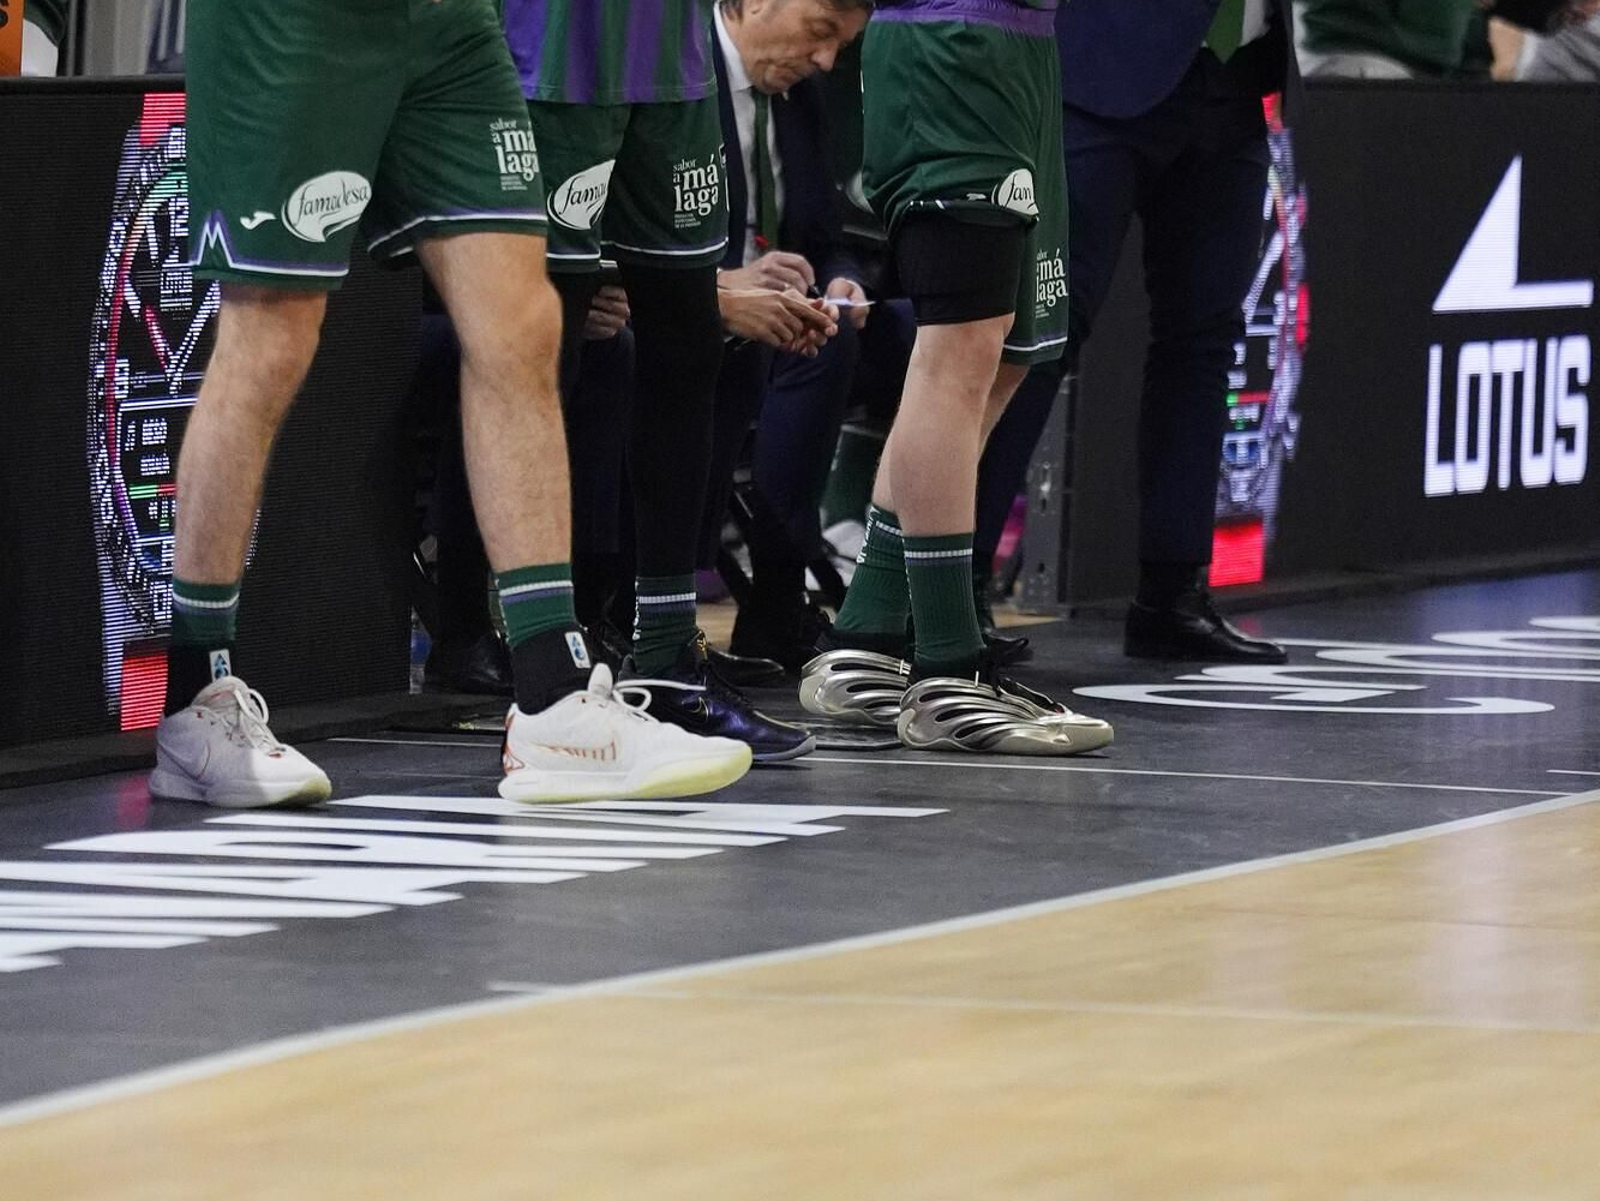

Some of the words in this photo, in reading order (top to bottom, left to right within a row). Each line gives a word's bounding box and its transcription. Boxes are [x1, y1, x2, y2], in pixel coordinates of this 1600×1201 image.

[683, 153, 720, 191] má
[673, 184, 719, 216] laga
[1423, 334, 1592, 497] LOTUS
